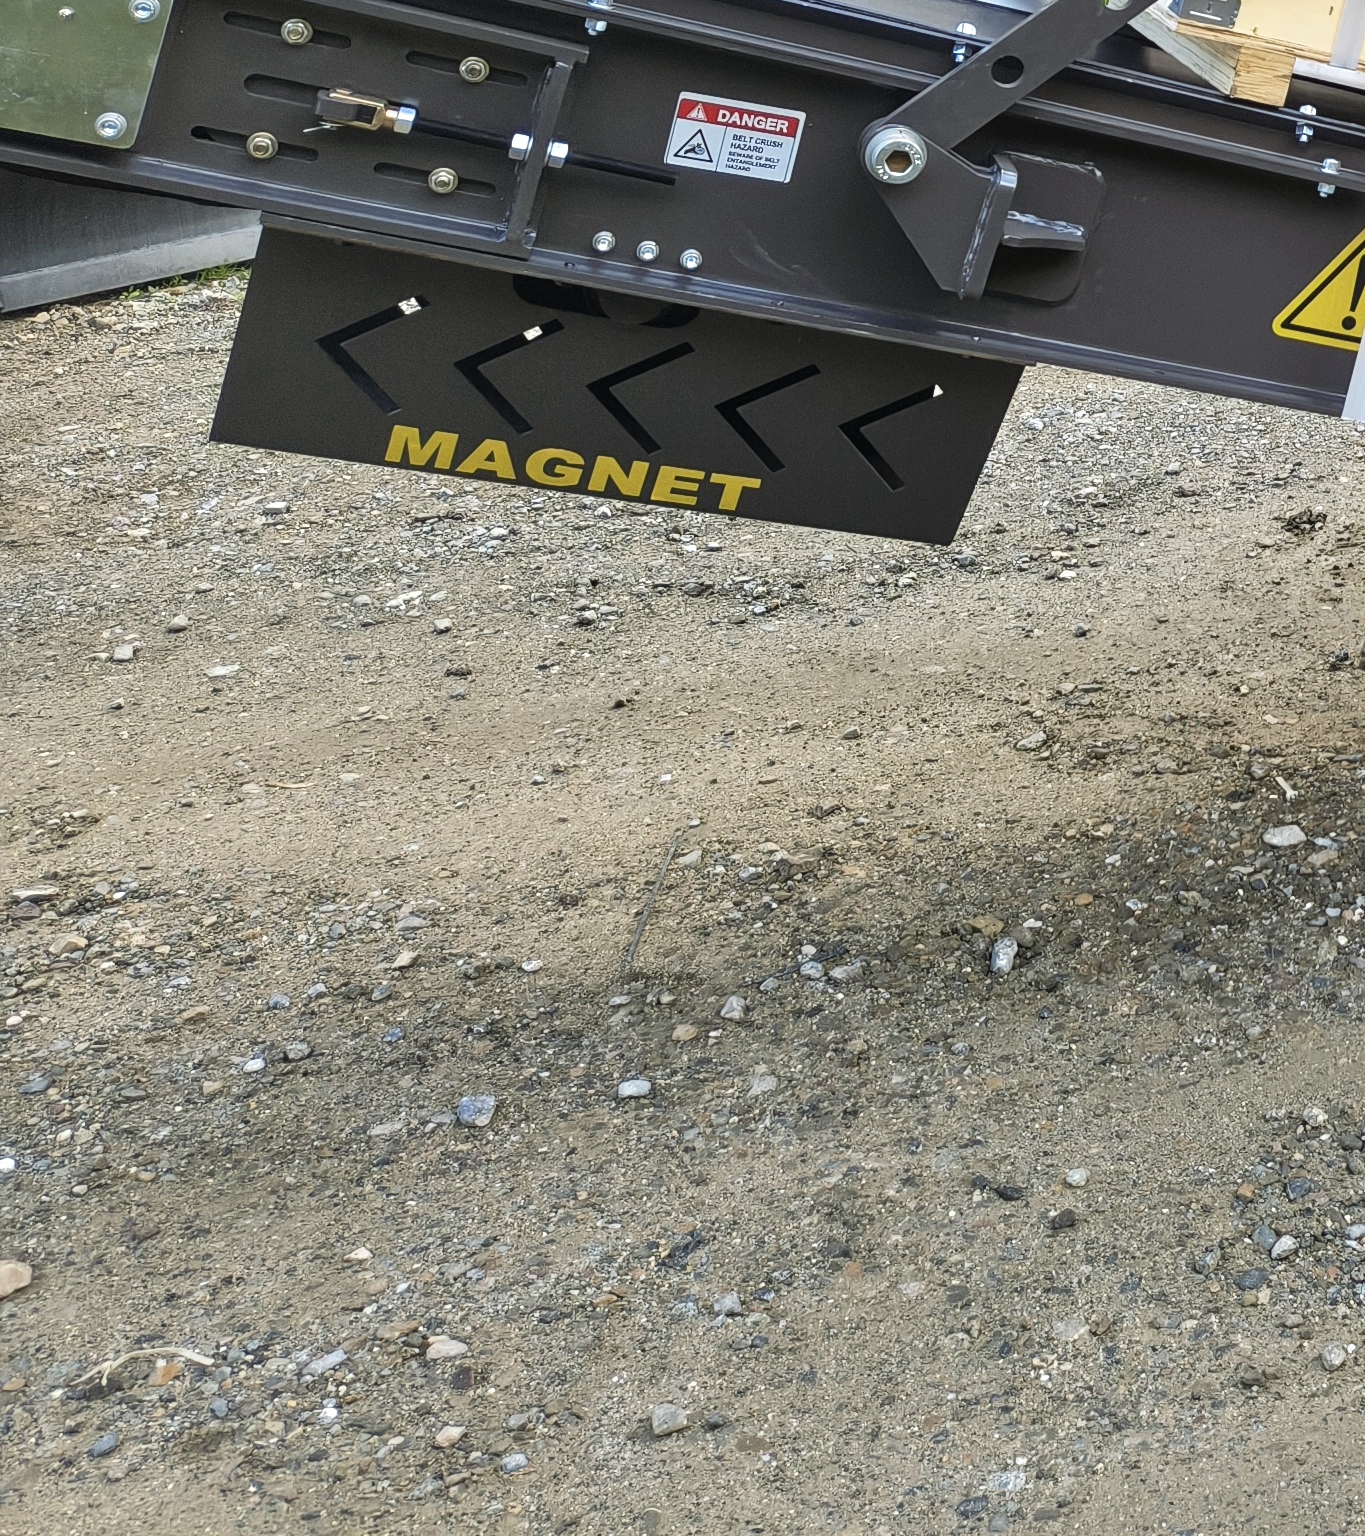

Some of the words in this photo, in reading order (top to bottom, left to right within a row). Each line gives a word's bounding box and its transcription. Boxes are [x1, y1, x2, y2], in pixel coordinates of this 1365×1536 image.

[716, 109, 789, 134] DANGER
[730, 142, 764, 154] HAZARD
[732, 133, 754, 144] BELT
[754, 138, 784, 149] CRUSH
[384, 424, 762, 512] MAGNET
